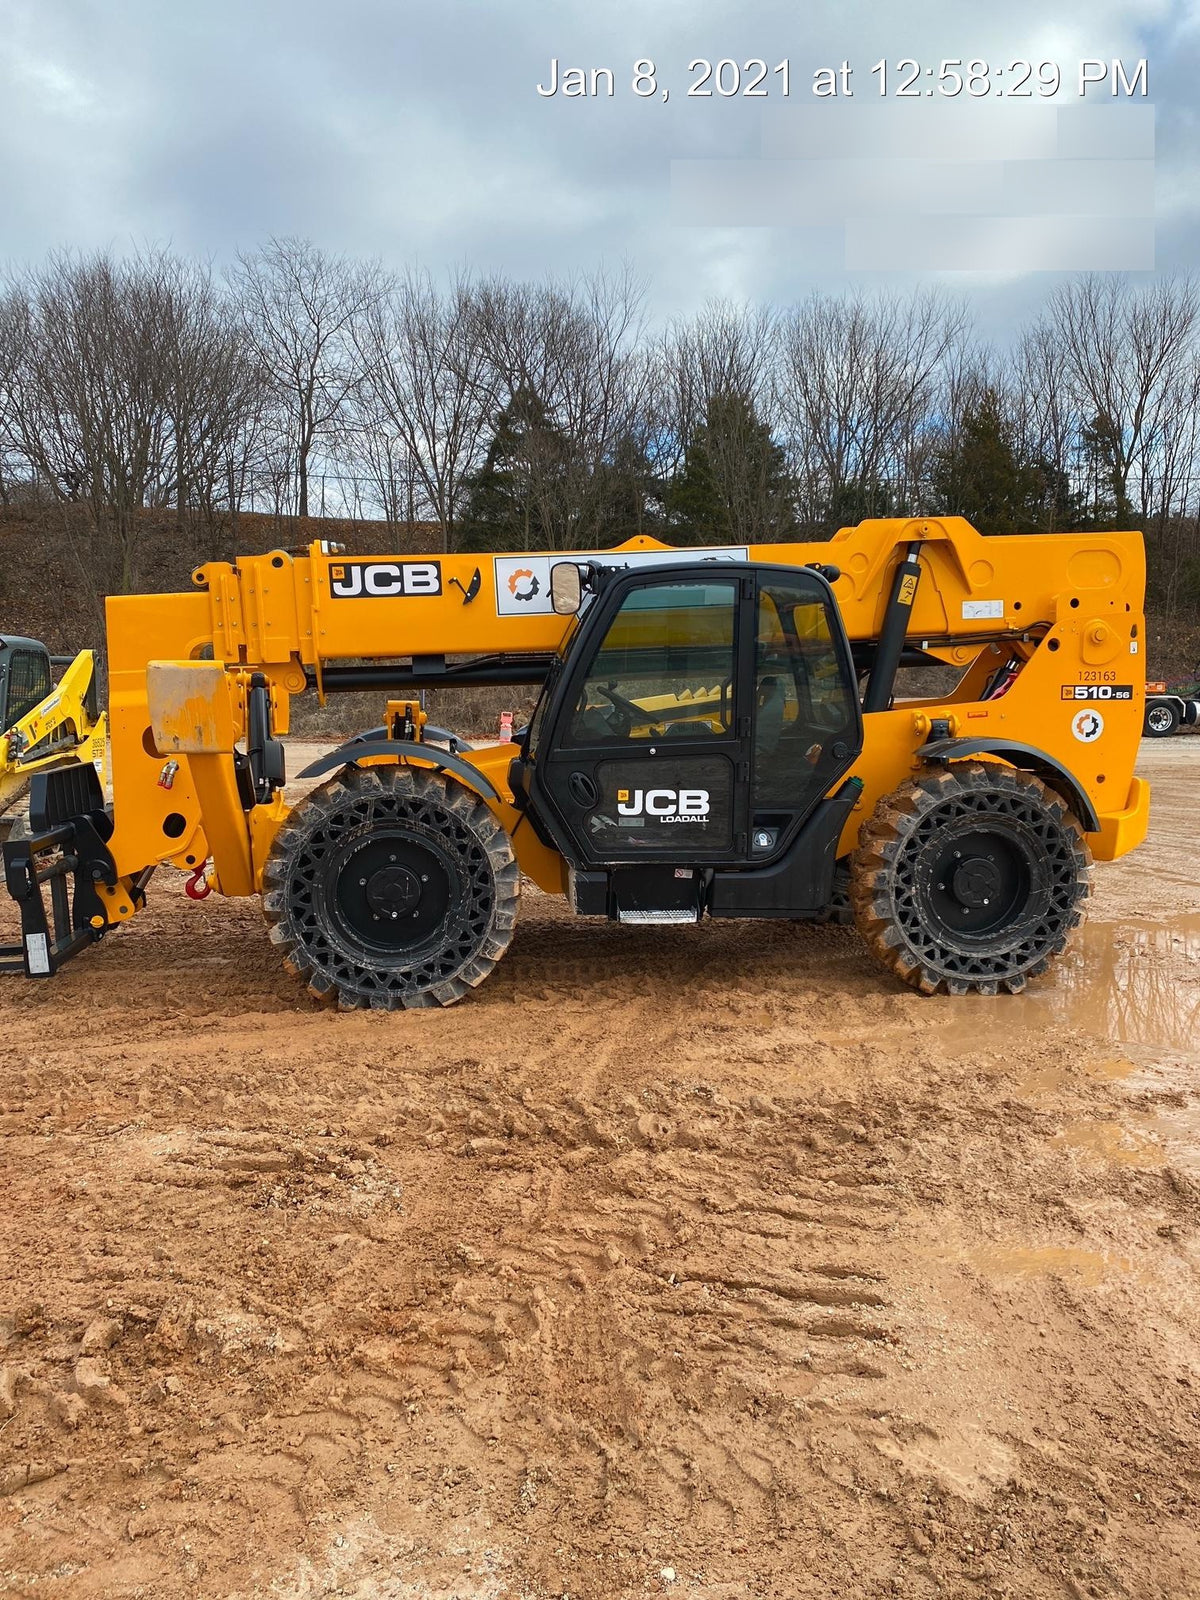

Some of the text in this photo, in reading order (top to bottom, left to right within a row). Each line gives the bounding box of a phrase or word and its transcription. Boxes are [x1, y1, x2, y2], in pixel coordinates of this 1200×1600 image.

[332, 563, 441, 596] JCB
[1078, 670, 1116, 681] 123163
[617, 789, 710, 816] JCB
[660, 815, 710, 823] LOADALL
